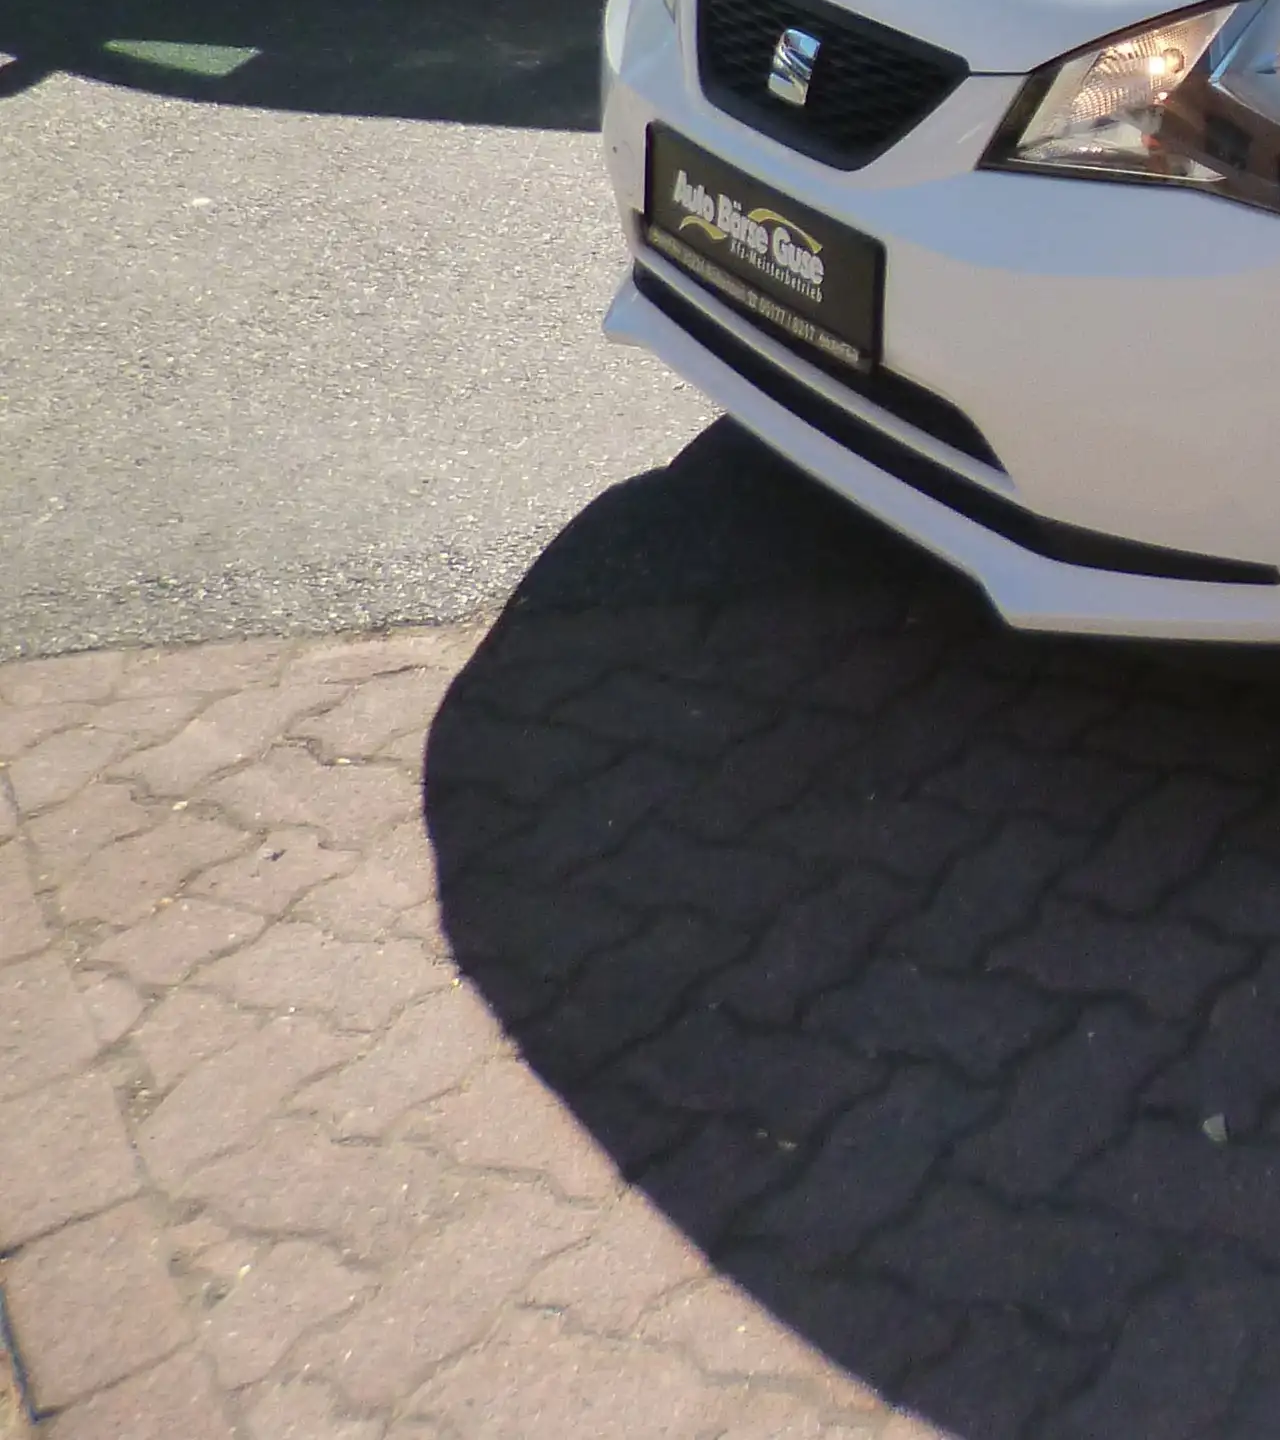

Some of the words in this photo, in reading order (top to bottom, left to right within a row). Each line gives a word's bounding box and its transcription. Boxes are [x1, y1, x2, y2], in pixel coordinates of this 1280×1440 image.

[673, 170, 714, 222] Auto
[717, 194, 769, 254] Börse
[773, 226, 824, 284] Guse
